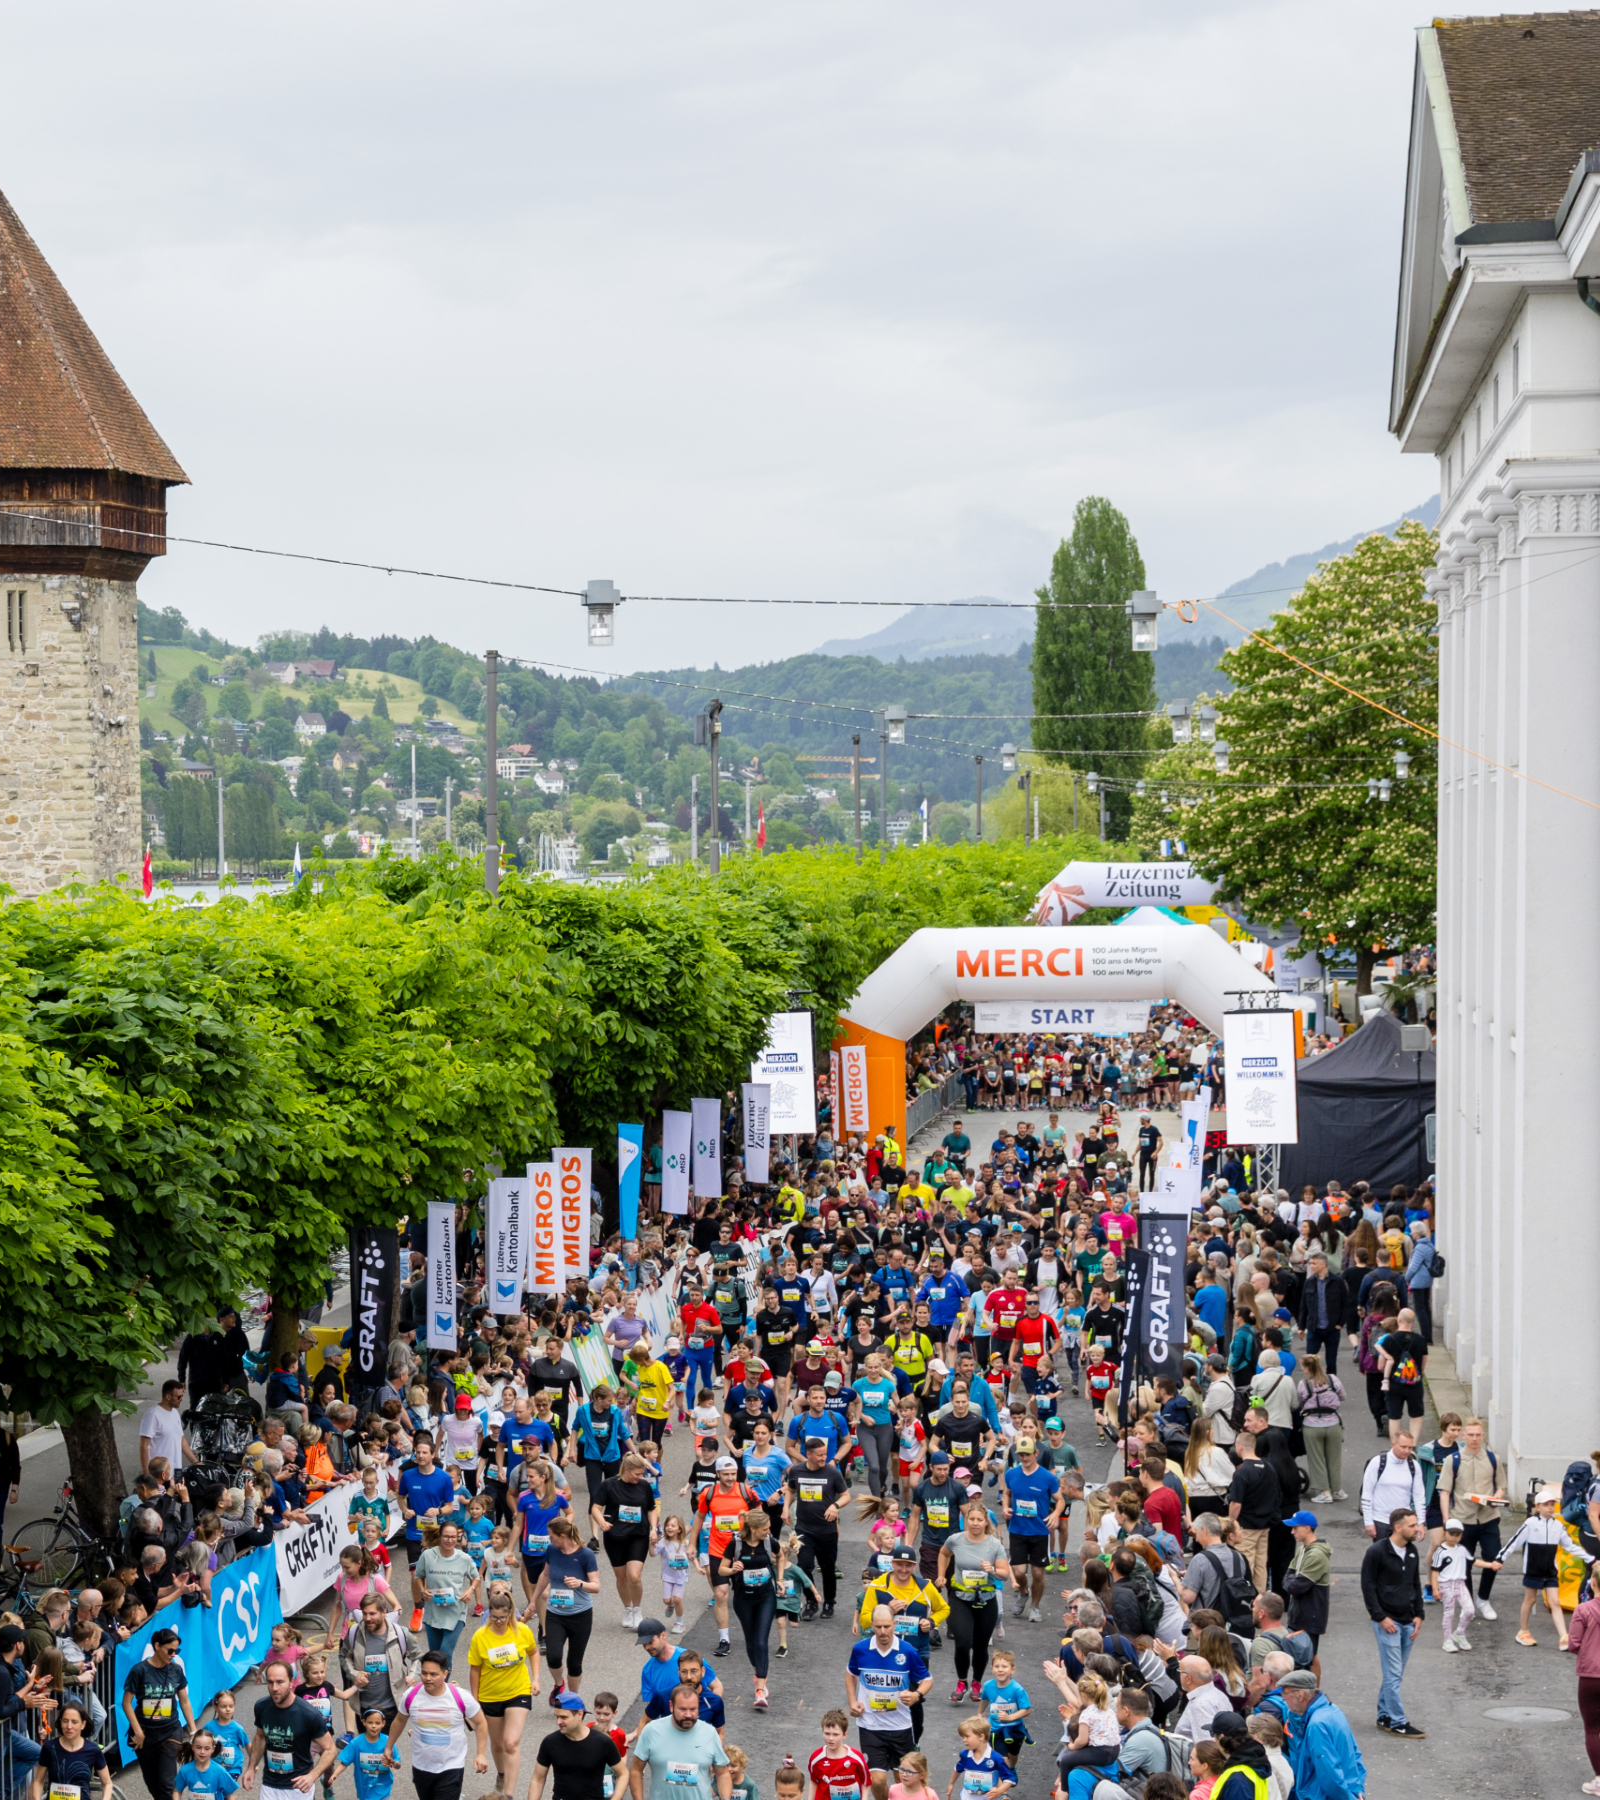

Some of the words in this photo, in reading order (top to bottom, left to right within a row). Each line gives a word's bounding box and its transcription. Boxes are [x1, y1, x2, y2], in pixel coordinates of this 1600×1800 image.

[1105, 881, 1181, 900] Zeitung
[956, 948, 1084, 978] MERCI
[1107, 946, 1129, 954] Jahre
[1130, 945, 1158, 955] Migros
[1123, 957, 1134, 965] de
[1135, 957, 1162, 965] Migros
[1126, 968, 1152, 977] Migros
[1031, 1009, 1095, 1025] START
[761, 1066, 803, 1074] WILLKOMMEN
[767, 1054, 797, 1063] HERZLICH
[1242, 1058, 1276, 1067] HERZLICH
[1236, 1070, 1284, 1079] WILLKOMMEN
[747, 1097, 755, 1148] Luzerner
[755, 1106, 768, 1149] Zeitung
[562, 1156, 581, 1267] MIGROS
[507, 1190, 519, 1274] Kantonalbank
[535, 1171, 556, 1285] MIGROS
[442, 1216, 453, 1306] Kantonalbank
[496, 1230, 506, 1273] Luzerner
[360, 1268, 381, 1373] CRAFT
[1148, 1256, 1172, 1363] CRAFT
[284, 1518, 326, 1578] CRAFT
[217, 1571, 261, 1662] CSS
[864, 1672, 885, 1686] Siehe
[885, 1673, 901, 1687] LNN
[673, 1768, 692, 1776] ANDRÉ
